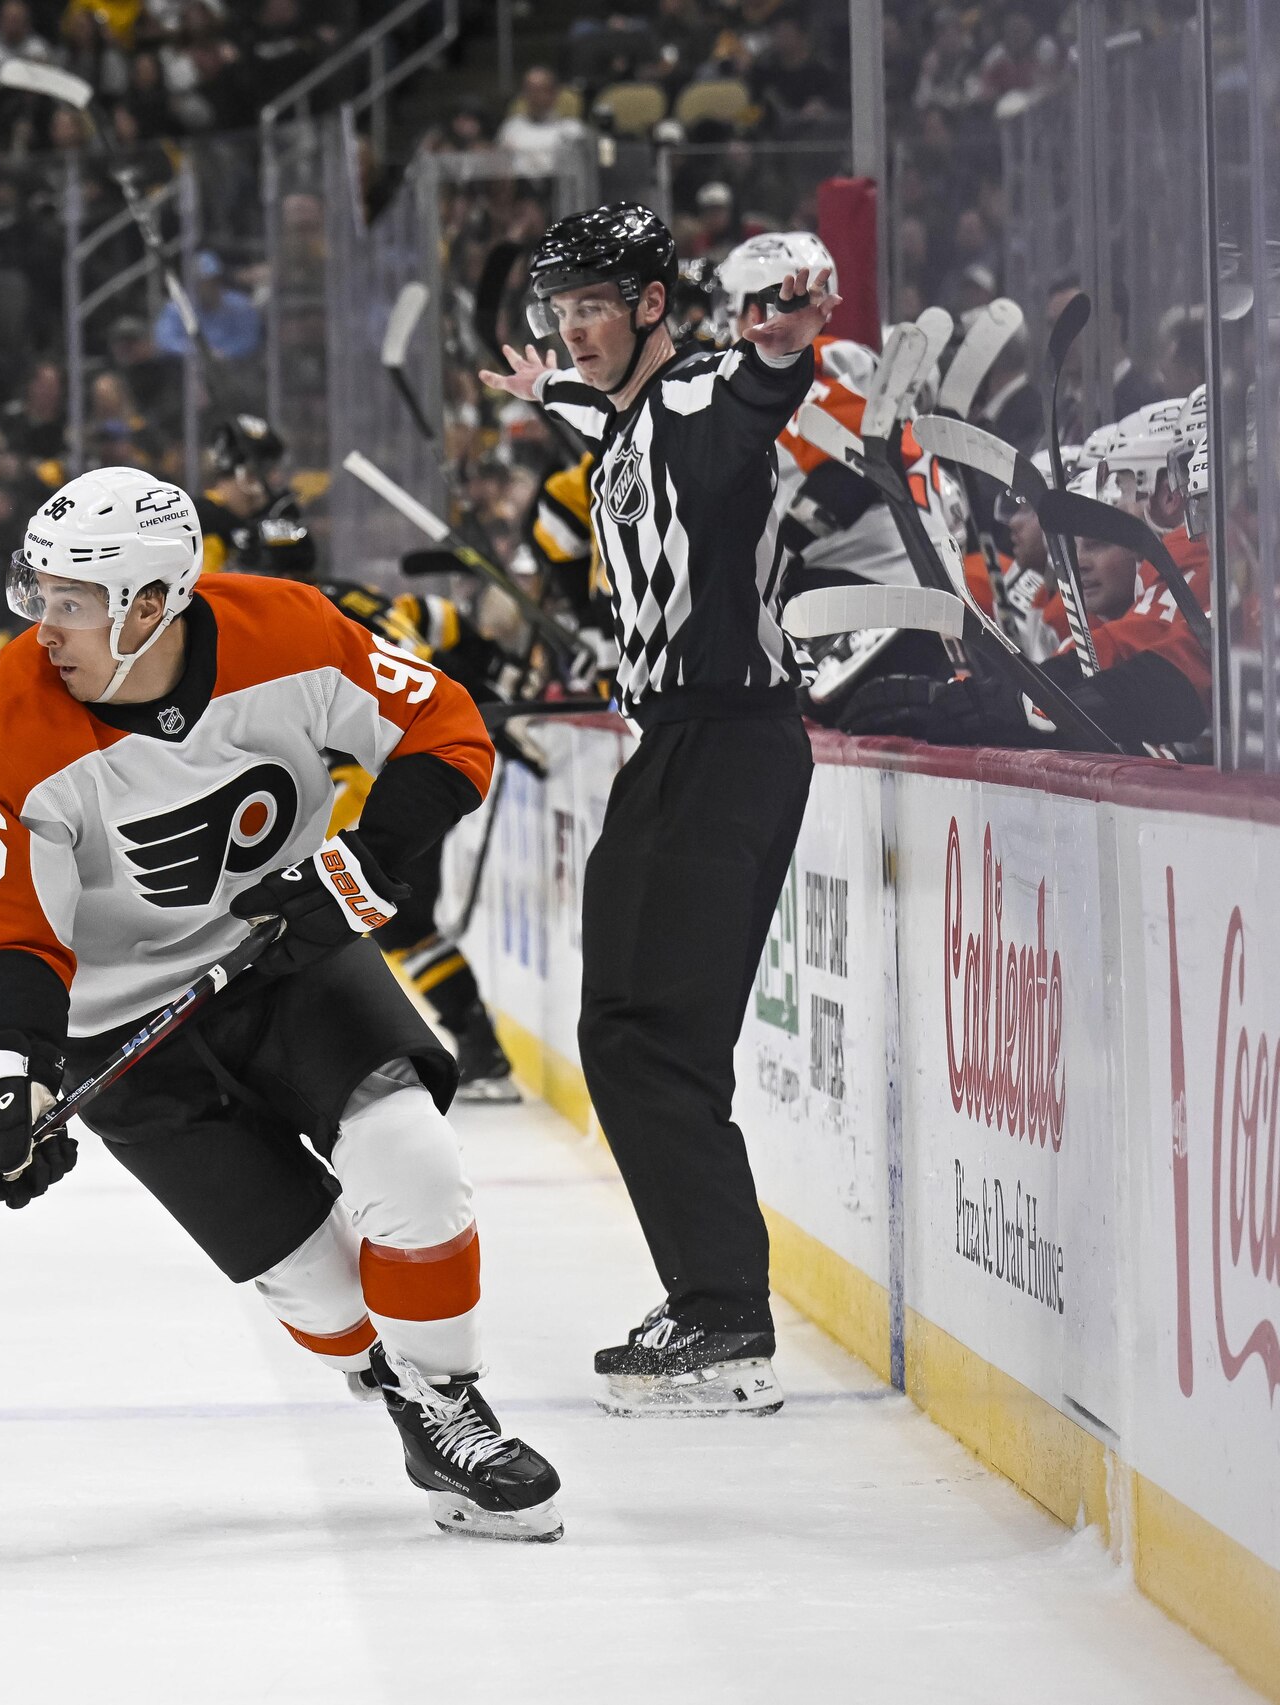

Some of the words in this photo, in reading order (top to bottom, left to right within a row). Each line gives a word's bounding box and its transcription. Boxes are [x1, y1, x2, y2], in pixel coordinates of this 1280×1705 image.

[613, 466, 633, 510] NHL
[44, 496, 75, 521] 96
[139, 509, 190, 528] CHEVROLET
[321, 849, 393, 930] BAUE
[945, 816, 1066, 1153] Caliente
[66, 1077, 95, 1102] KUZMENKO
[954, 1158, 981, 1267] Pizza
[982, 1177, 993, 1275] &
[994, 1178, 1025, 1293] Draft
[1025, 1193, 1065, 1315] House
[434, 1470, 470, 1492] BAUER
